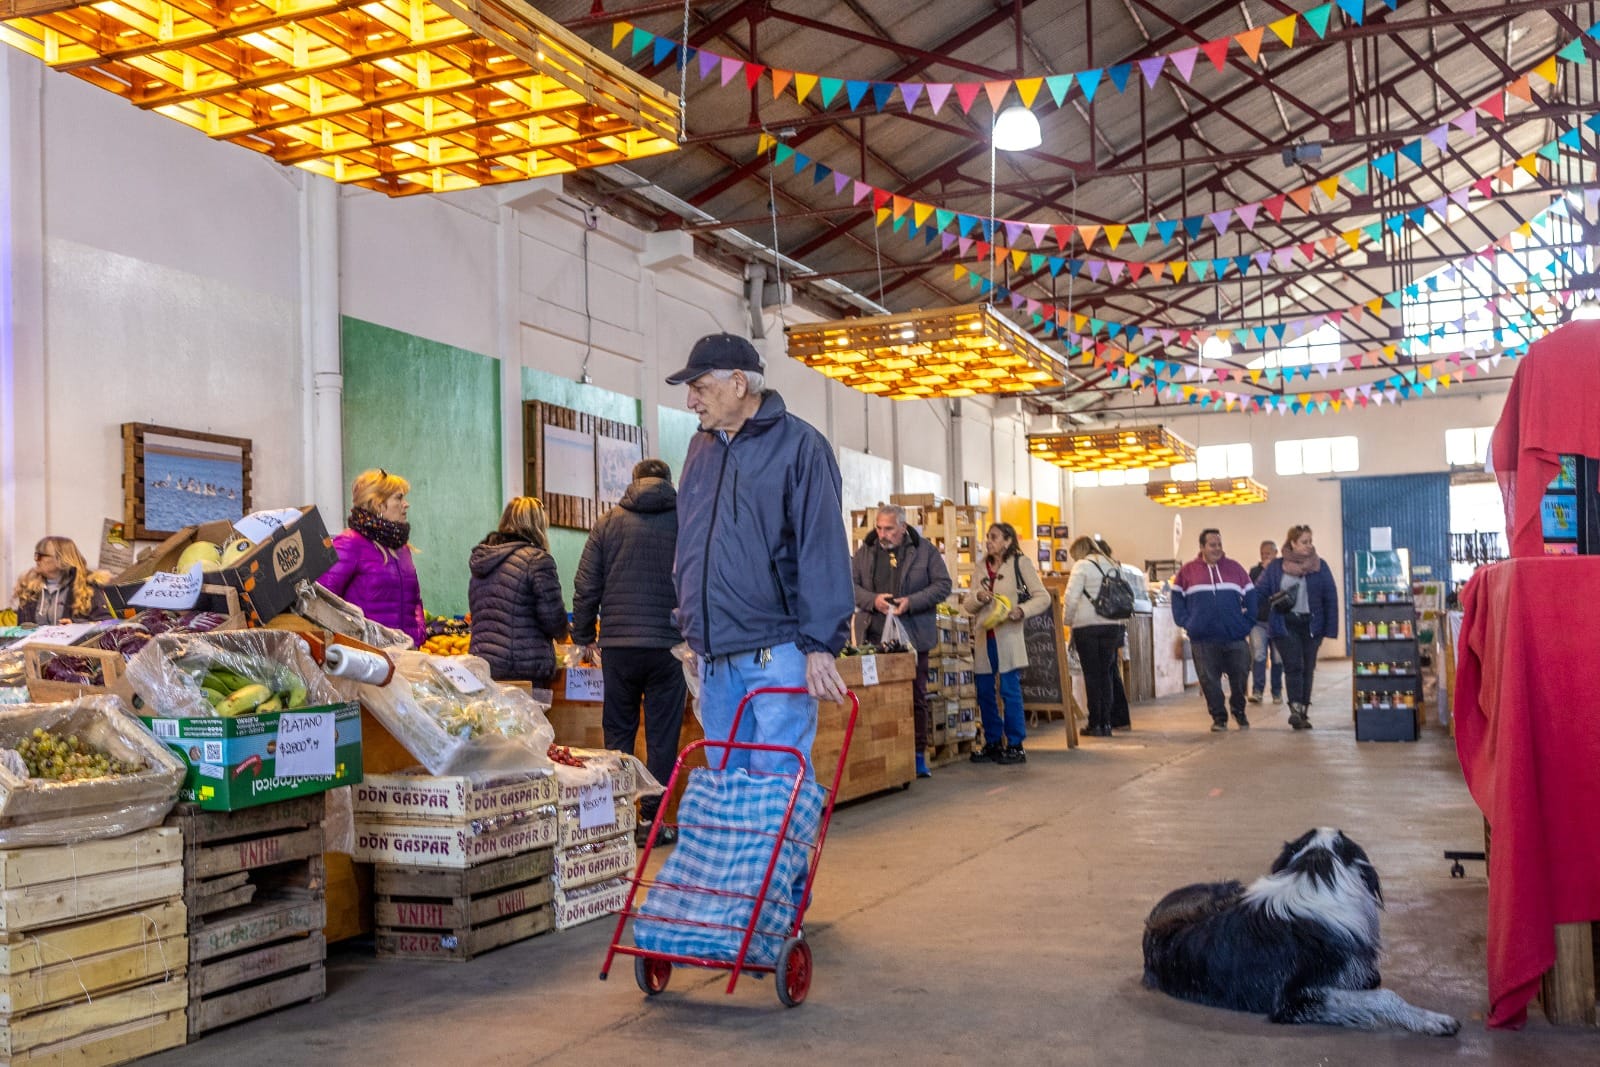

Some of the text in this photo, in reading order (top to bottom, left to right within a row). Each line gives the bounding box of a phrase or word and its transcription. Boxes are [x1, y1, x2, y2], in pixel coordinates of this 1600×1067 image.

[280, 715, 323, 736] PLATANO
[392, 792, 448, 809] GASPAR
[501, 787, 540, 806] GASPAR
[394, 839, 450, 856] GASPAR
[501, 829, 539, 849] GASPAR
[588, 856, 620, 873] GASPAR
[587, 895, 621, 914] GASPAR
